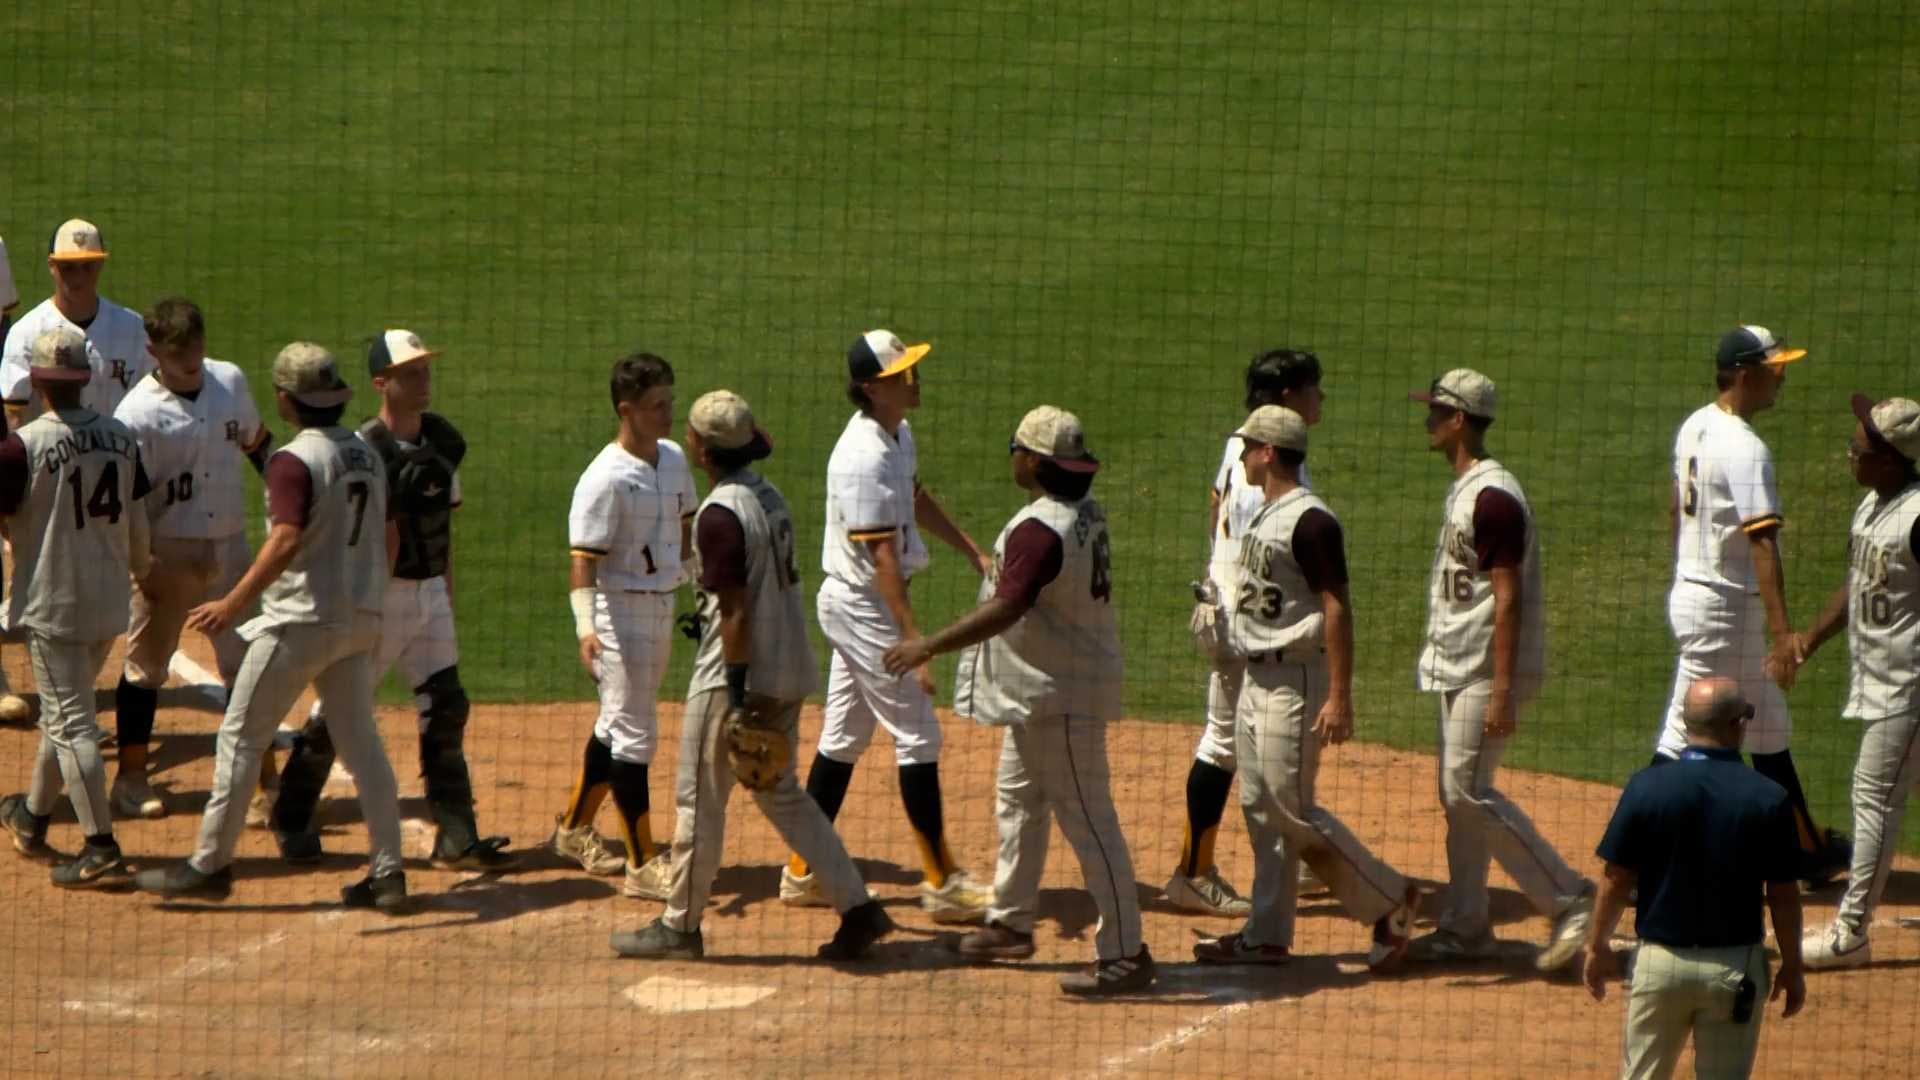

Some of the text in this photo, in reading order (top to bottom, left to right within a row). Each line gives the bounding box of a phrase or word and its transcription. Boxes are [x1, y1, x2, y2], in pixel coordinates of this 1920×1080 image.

[67, 461, 122, 530] 14
[347, 481, 368, 546] 7
[641, 544, 658, 575] 1
[1239, 583, 1283, 620] 23
[1443, 567, 1473, 602] 16
[1861, 592, 1890, 626] 10
